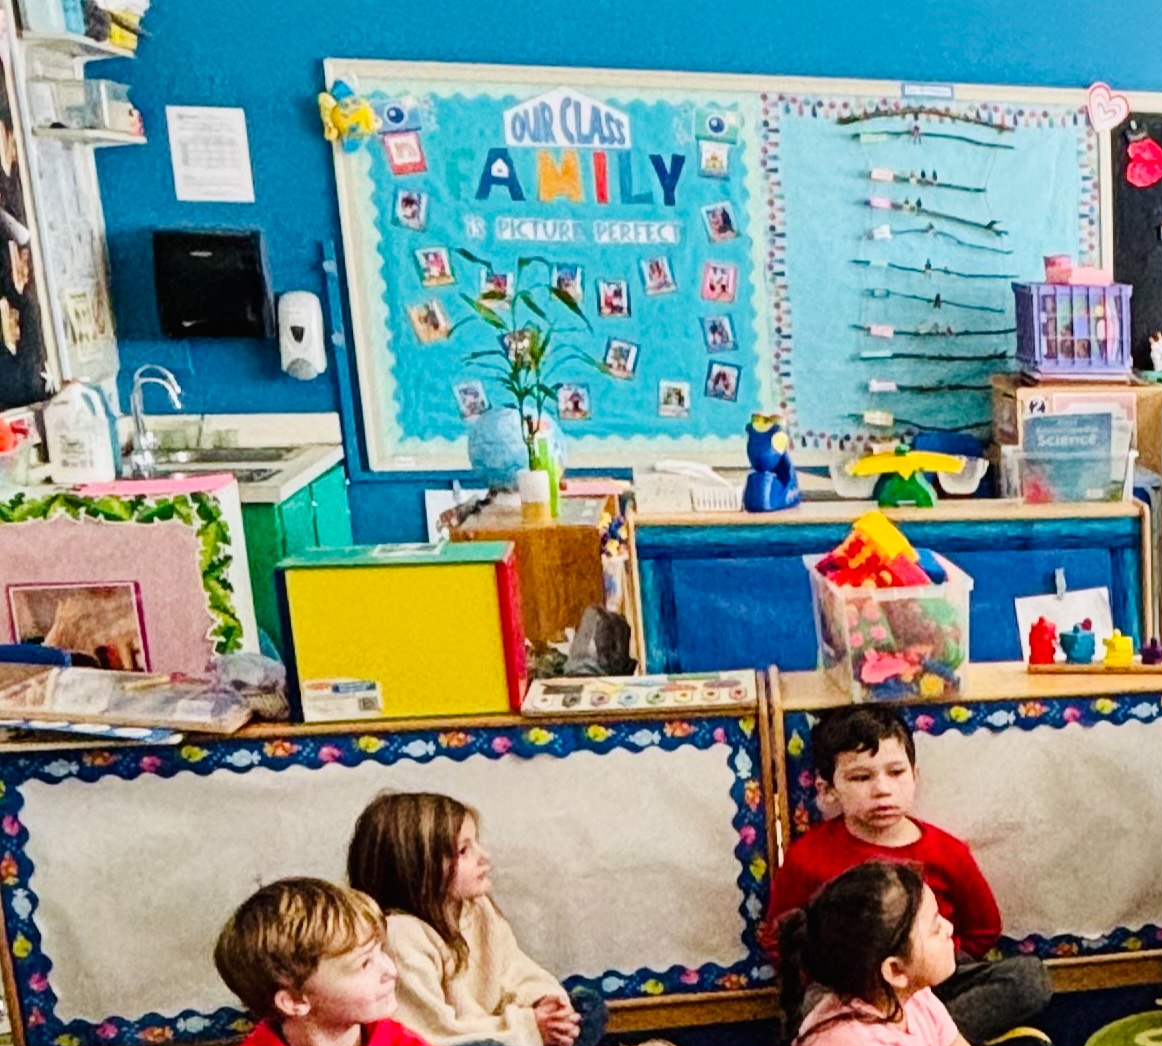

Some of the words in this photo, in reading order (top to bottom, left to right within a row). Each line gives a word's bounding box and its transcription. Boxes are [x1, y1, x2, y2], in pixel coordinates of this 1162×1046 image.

[511, 101, 557, 144] OUR
[560, 97, 625, 145] CLASS
[595, 221, 681, 243] PERFECT
[1037, 434, 1098, 448] Science
